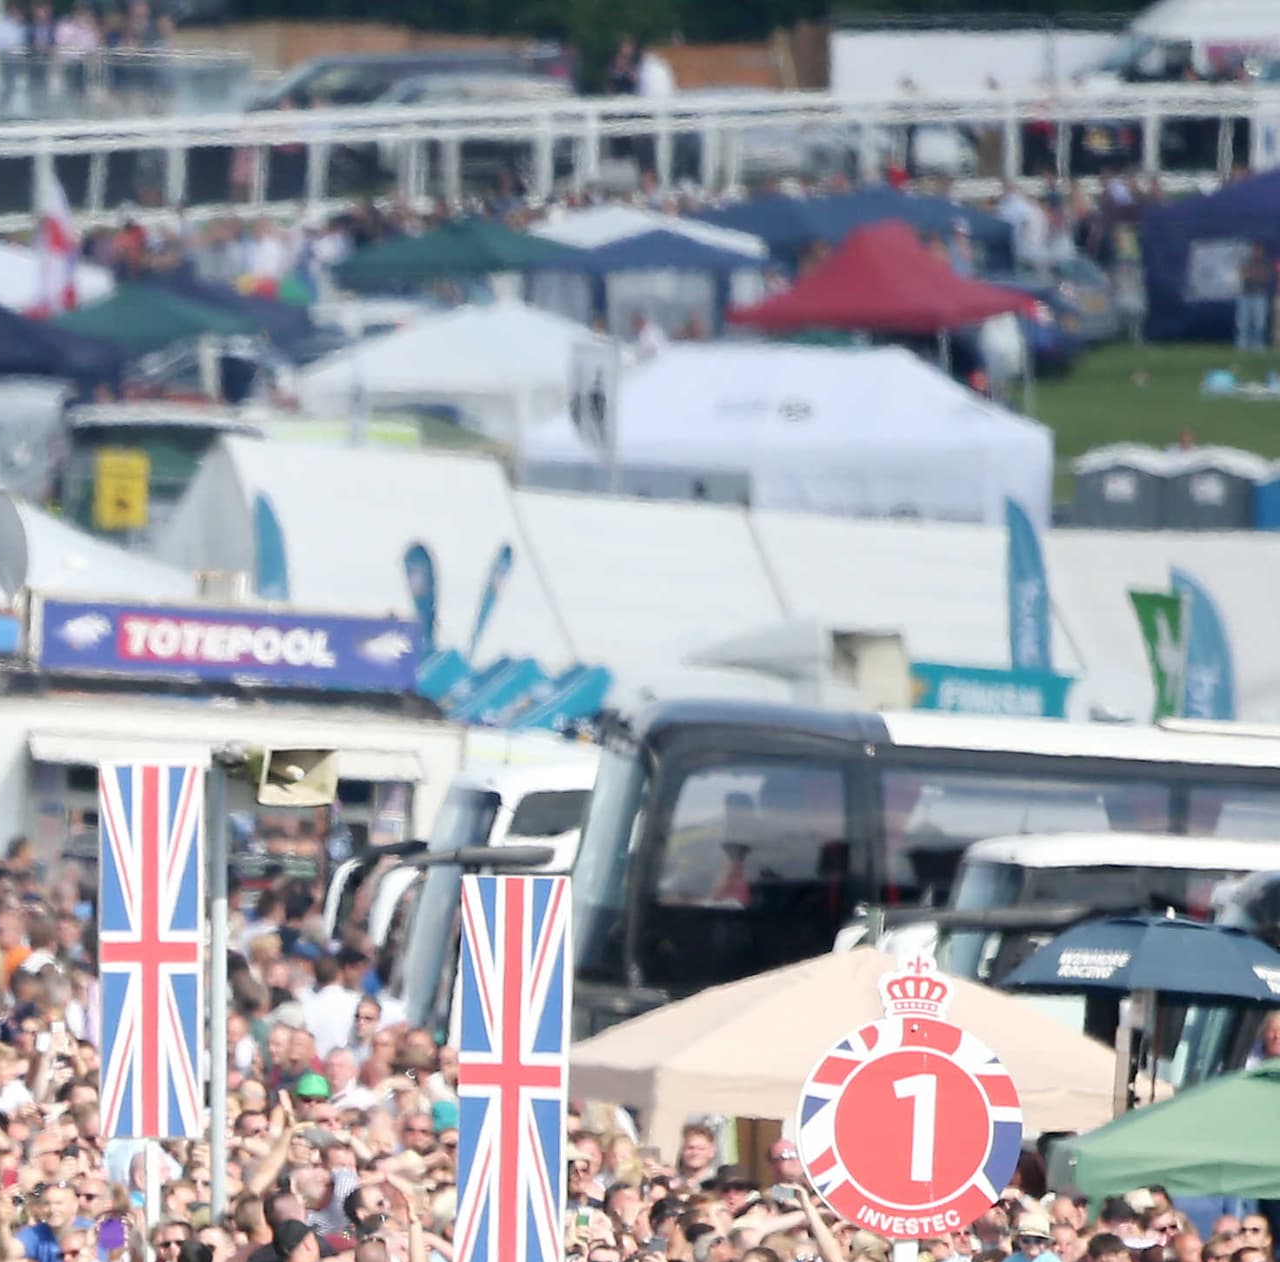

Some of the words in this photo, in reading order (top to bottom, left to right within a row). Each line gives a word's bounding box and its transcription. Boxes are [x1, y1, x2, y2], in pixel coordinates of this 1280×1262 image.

[124, 614, 336, 669] TOTEPOOL
[893, 1073, 937, 1182] 1
[856, 1205, 961, 1235] INVESTEC
